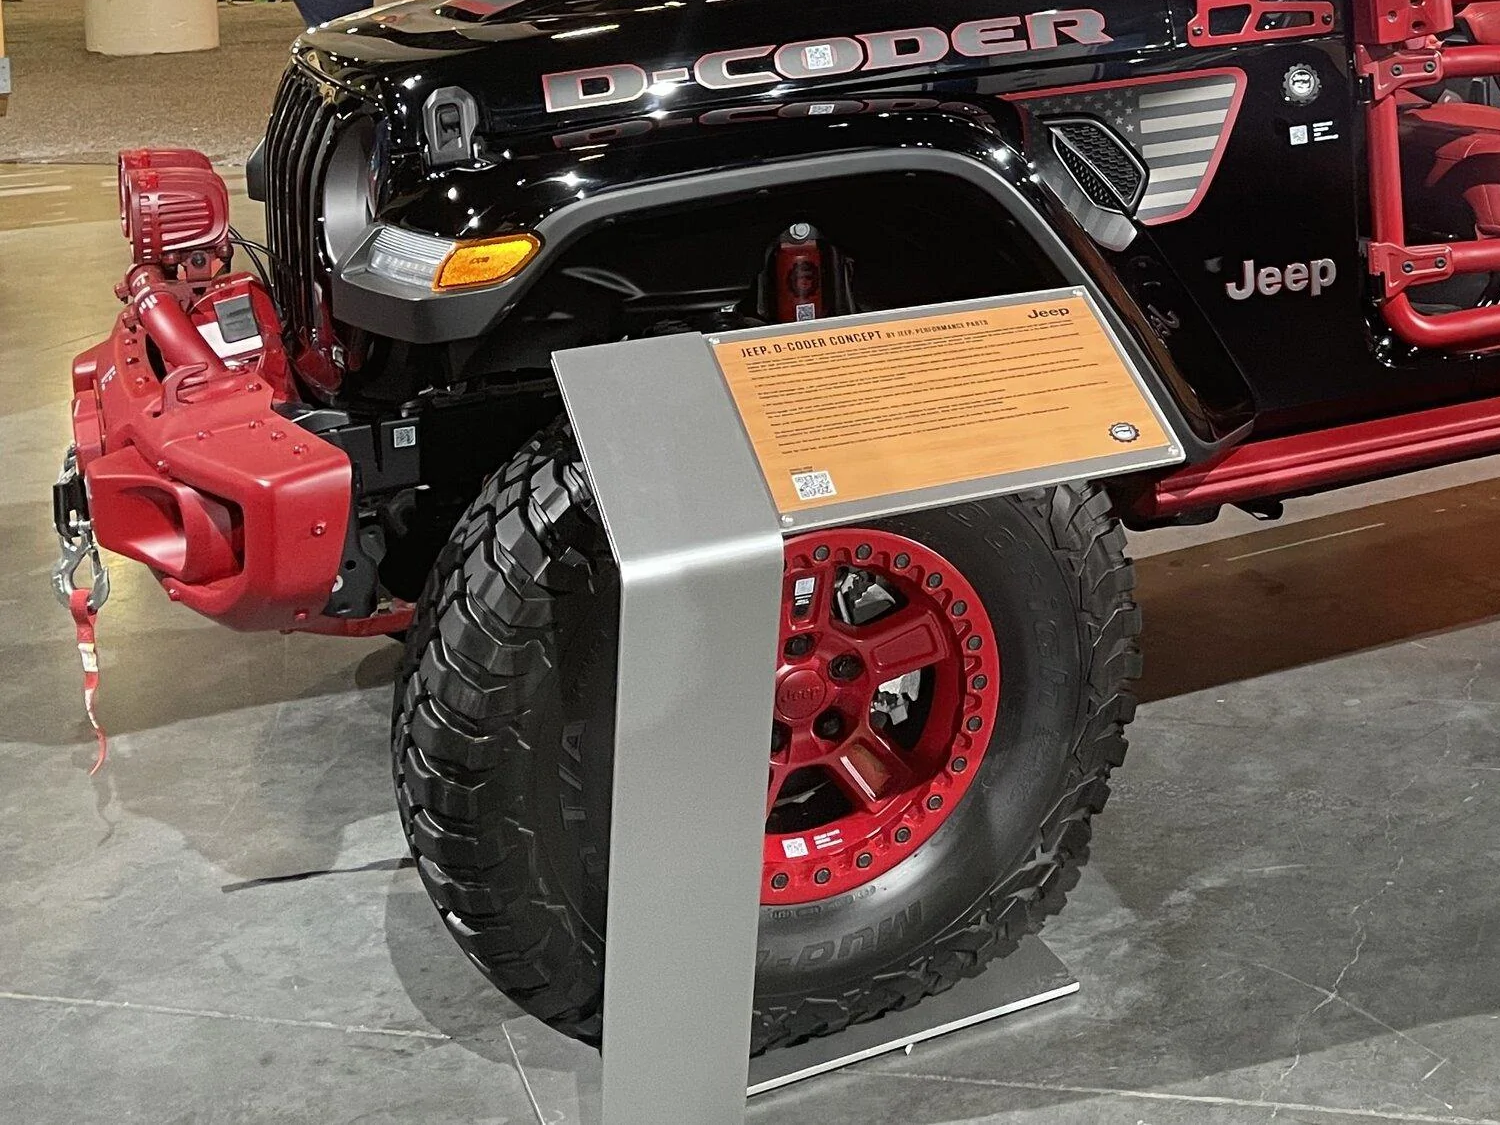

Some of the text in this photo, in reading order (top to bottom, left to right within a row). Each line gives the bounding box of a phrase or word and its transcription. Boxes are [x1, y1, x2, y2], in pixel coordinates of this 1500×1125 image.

[541, 7, 1115, 114] D-CODER
[1225, 258, 1337, 301] Jeep
[1027, 306, 1070, 319] Jeep
[774, 338, 828, 354] D-CODER
[829, 330, 883, 345] CONCEPT
